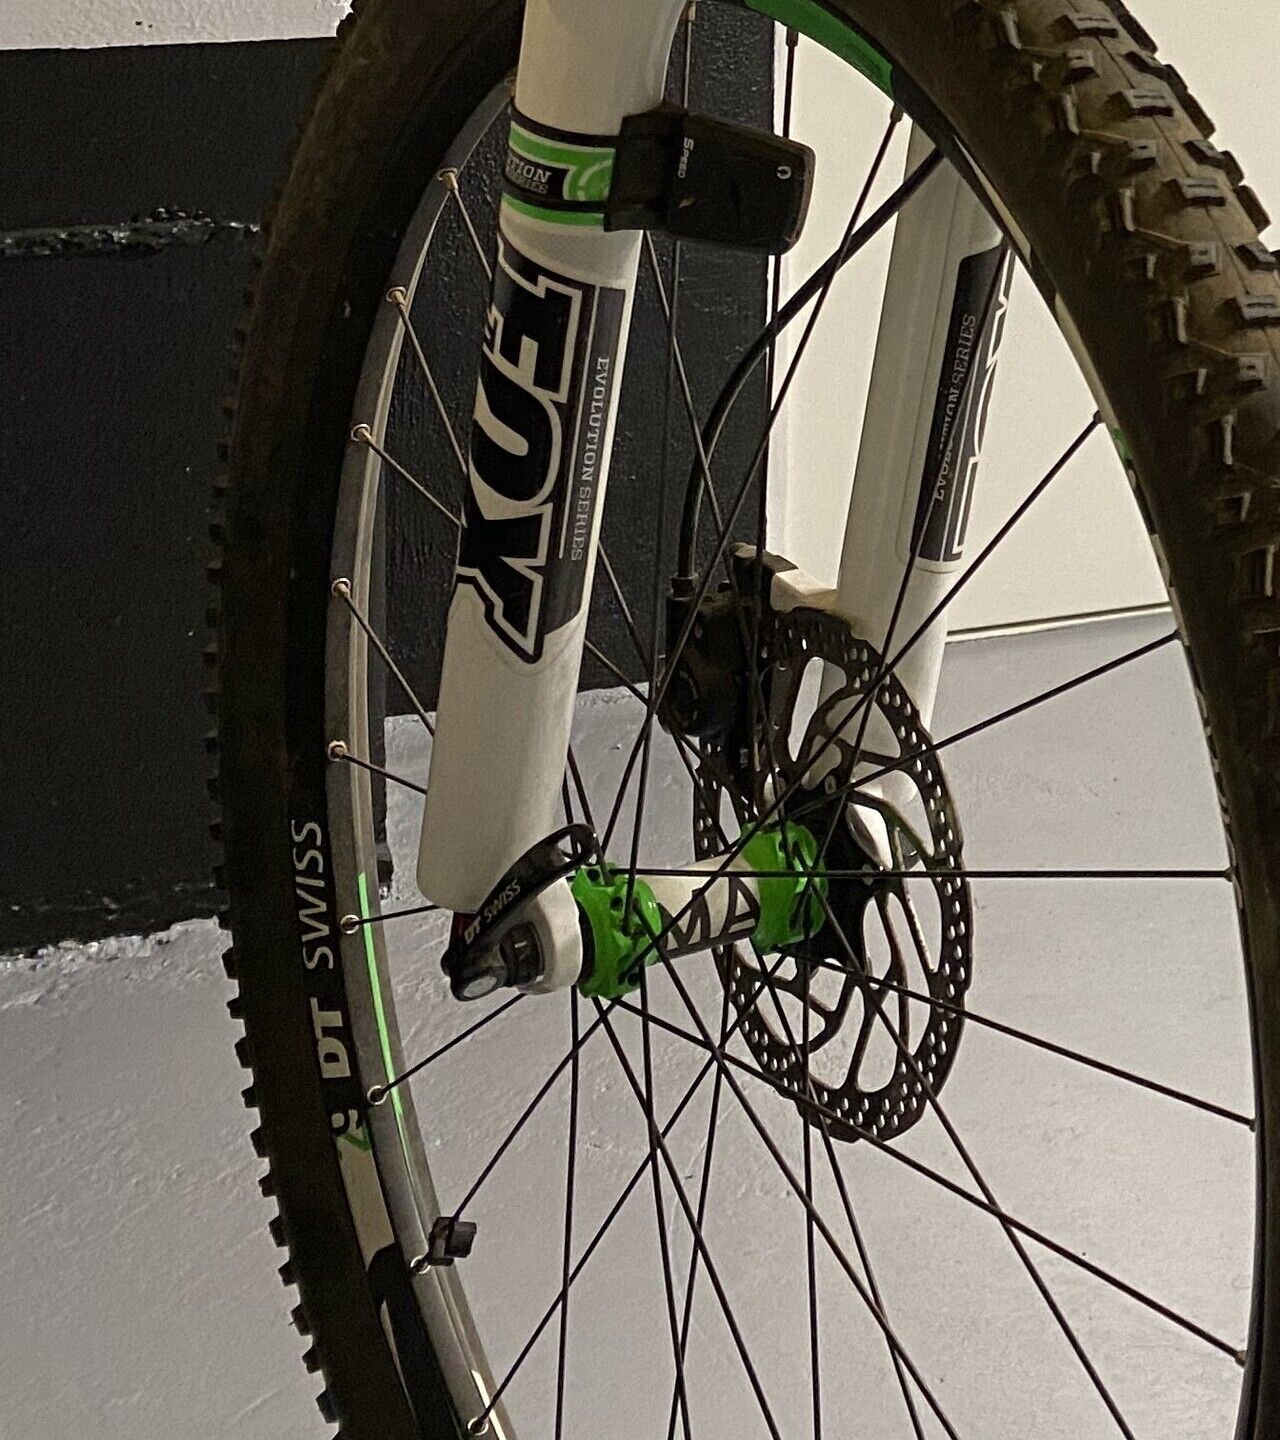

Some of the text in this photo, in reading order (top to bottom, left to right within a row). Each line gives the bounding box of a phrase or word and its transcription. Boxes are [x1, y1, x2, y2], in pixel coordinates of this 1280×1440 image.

[458, 274, 583, 657] FOX
[571, 356, 609, 561] EVOLUTION SERIES
[292, 819, 334, 970] SWISS
[464, 879, 521, 944] DT SWISS
[310, 996, 351, 1079] DT
